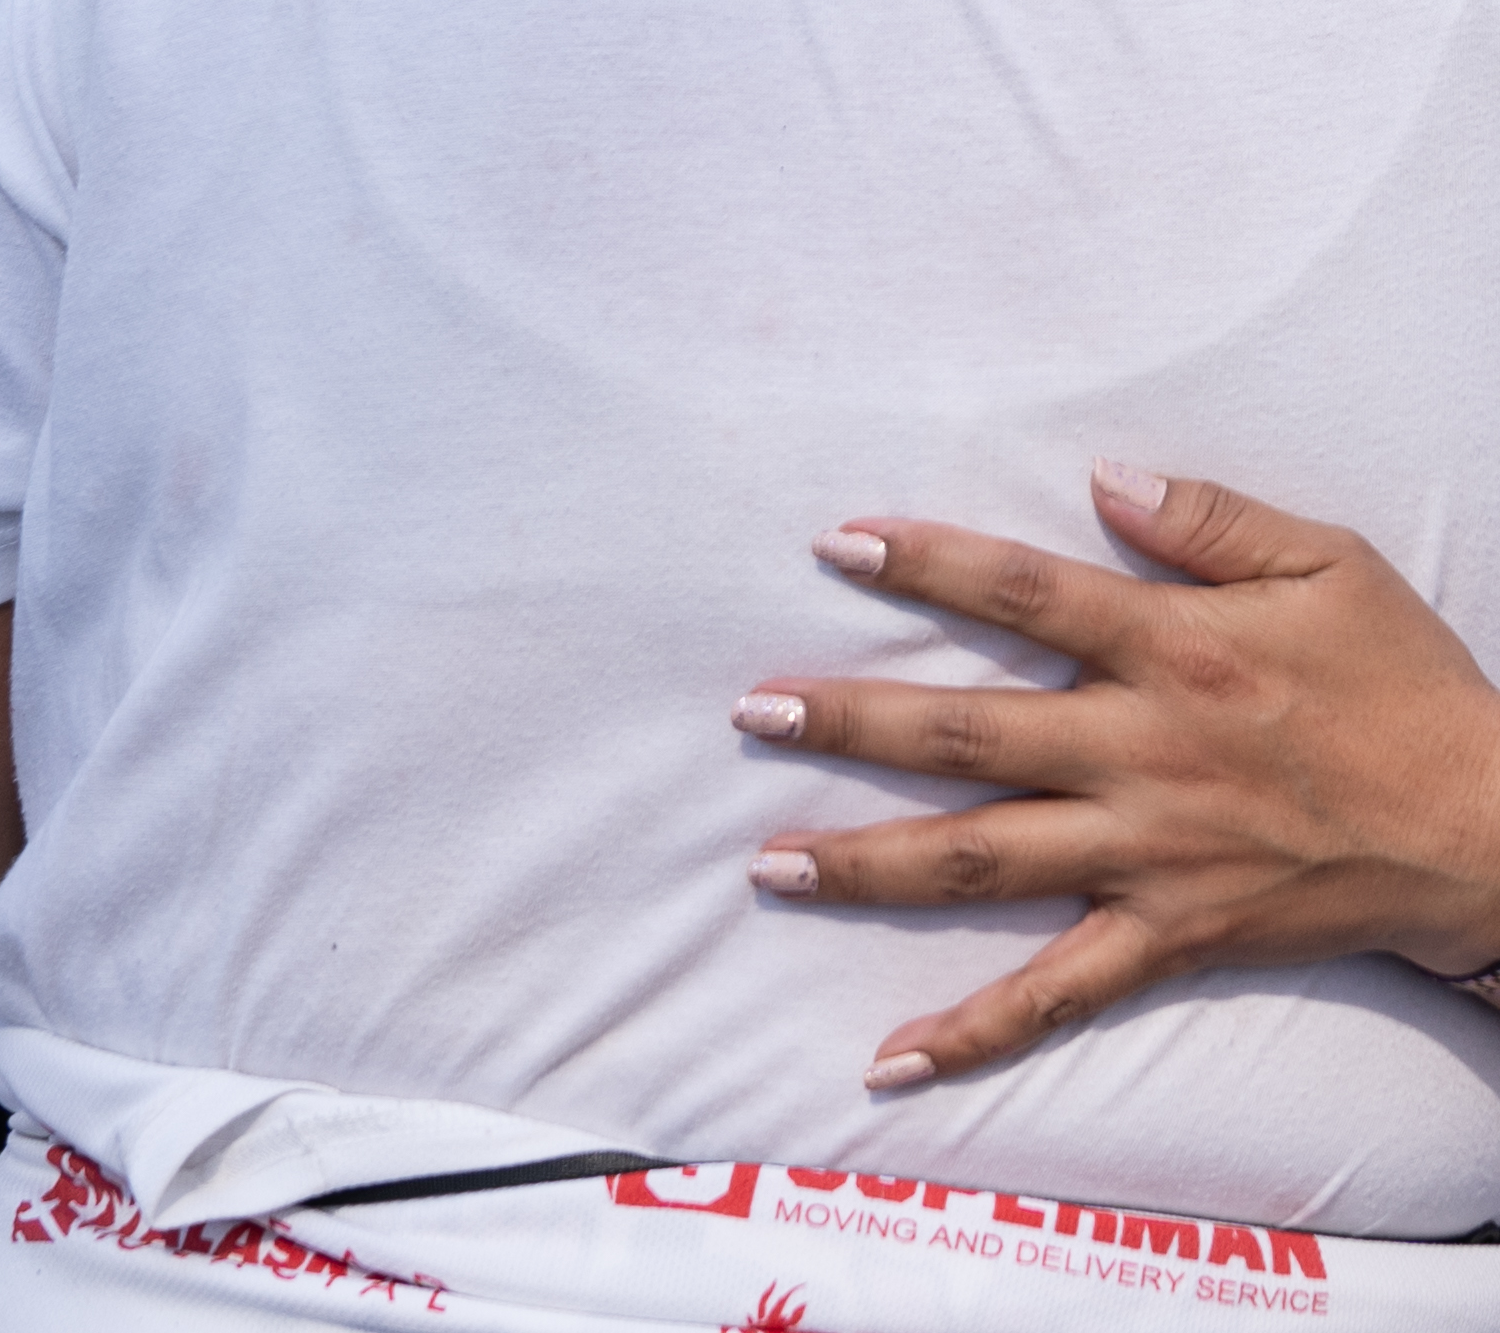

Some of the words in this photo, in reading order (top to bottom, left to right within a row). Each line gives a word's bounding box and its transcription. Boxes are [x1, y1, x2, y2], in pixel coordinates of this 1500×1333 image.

[774, 1197, 918, 1244] MOVING
[928, 1223, 1005, 1259] AND
[1014, 1238, 1186, 1294] DELIVERY
[1196, 1274, 1330, 1317] SERVICE
